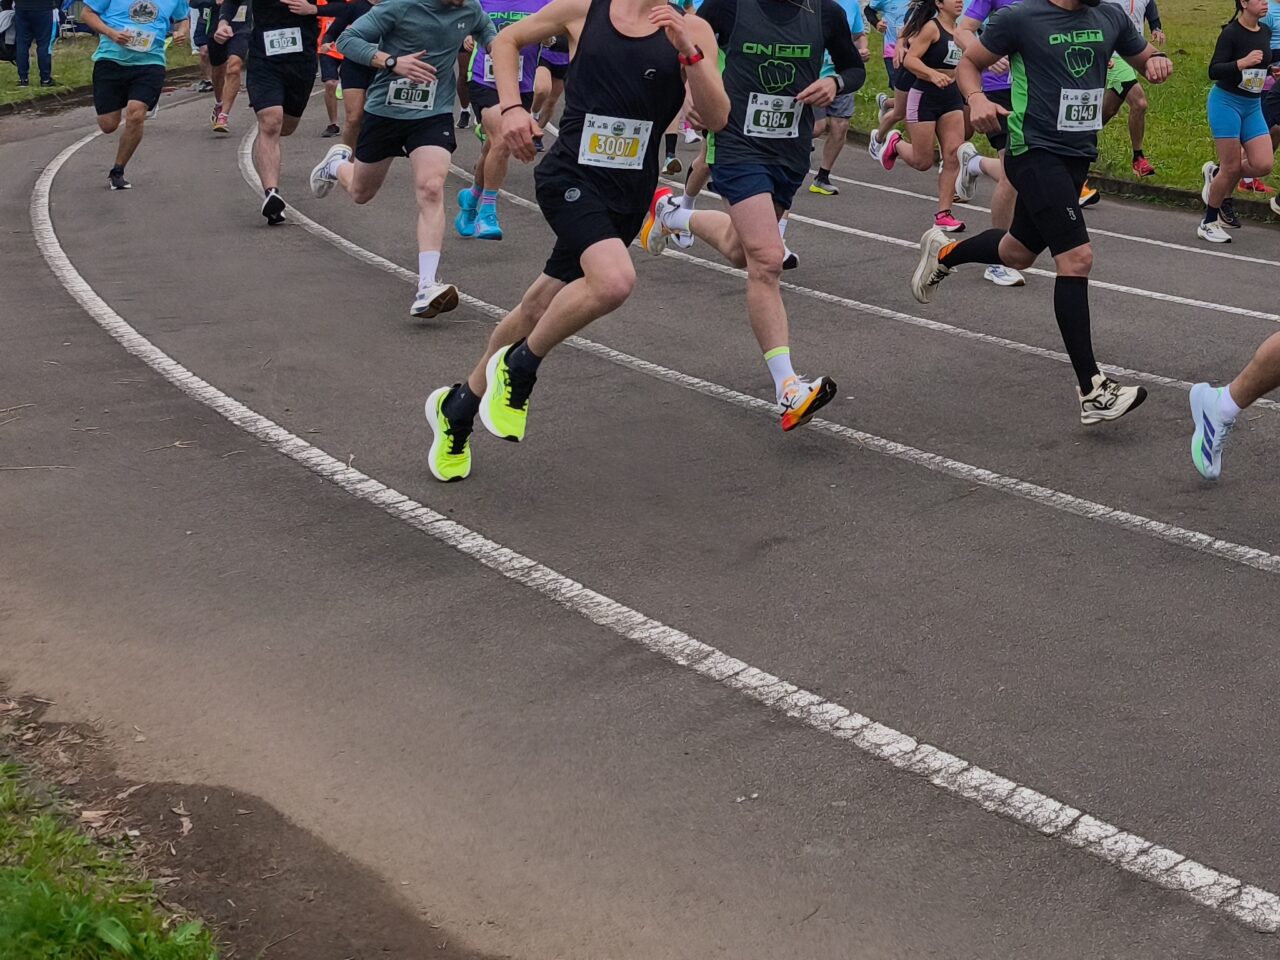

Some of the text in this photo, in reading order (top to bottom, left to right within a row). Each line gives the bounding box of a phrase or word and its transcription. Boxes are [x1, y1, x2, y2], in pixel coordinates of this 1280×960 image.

[273, 38, 294, 49] 6102
[1049, 30, 1103, 45] ON FIT
[742, 42, 811, 57] ON FIT
[400, 88, 423, 102] 6110
[760, 110, 788, 128] 6184
[1070, 105, 1094, 121] 6149
[595, 135, 634, 157] 3007
